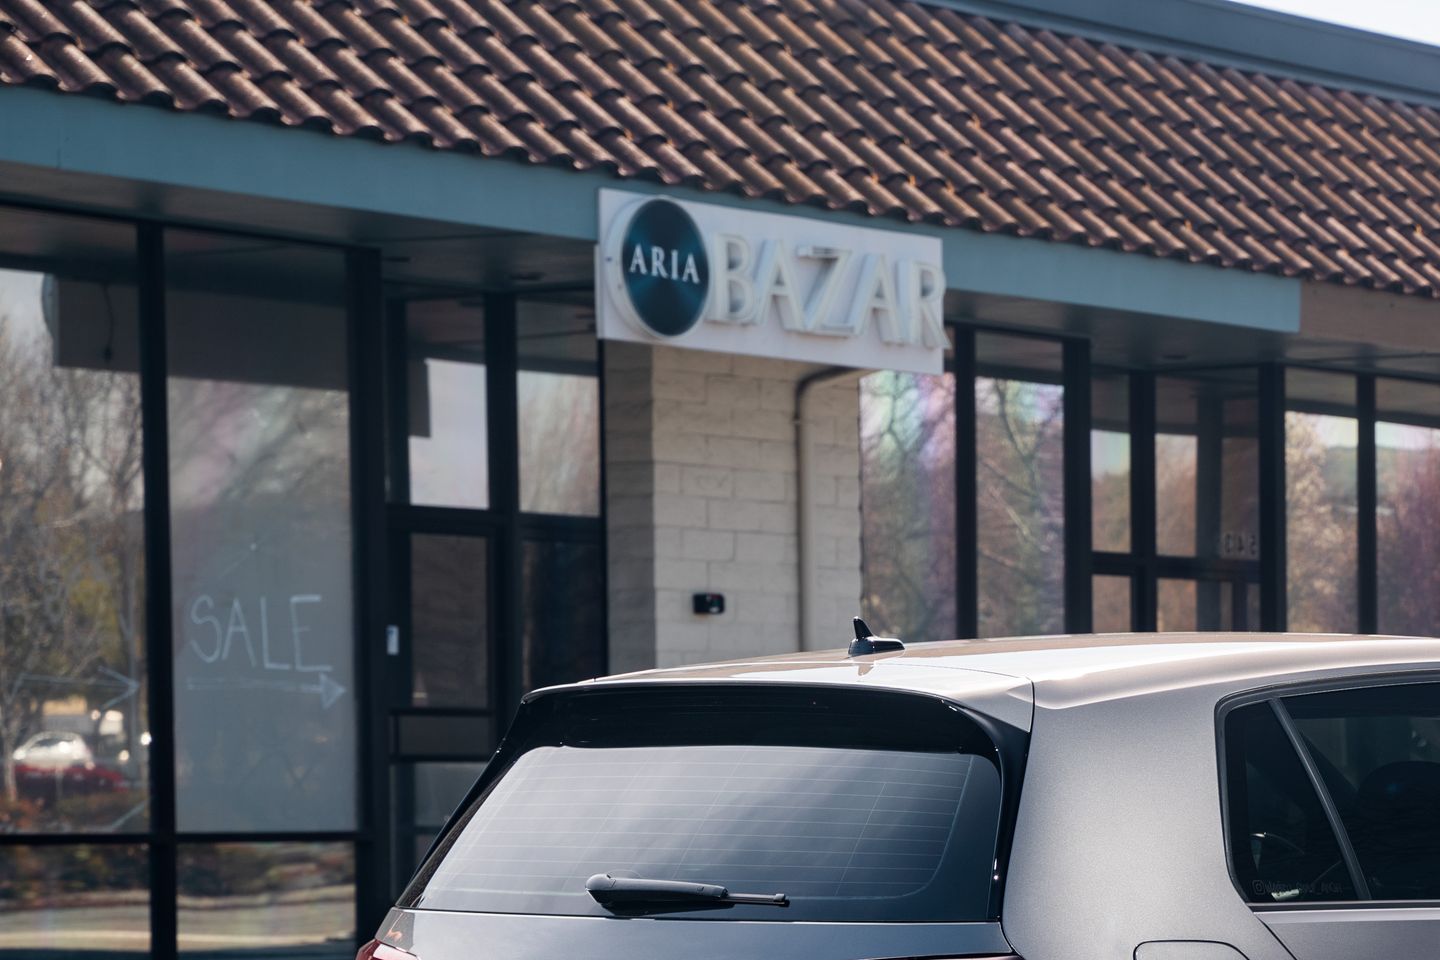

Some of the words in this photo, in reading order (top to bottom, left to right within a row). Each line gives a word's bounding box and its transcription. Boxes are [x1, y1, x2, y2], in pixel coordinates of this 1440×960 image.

[629, 244, 700, 284] ARIA
[704, 234, 950, 349] BAZAR
[189, 594, 333, 672] SALE
